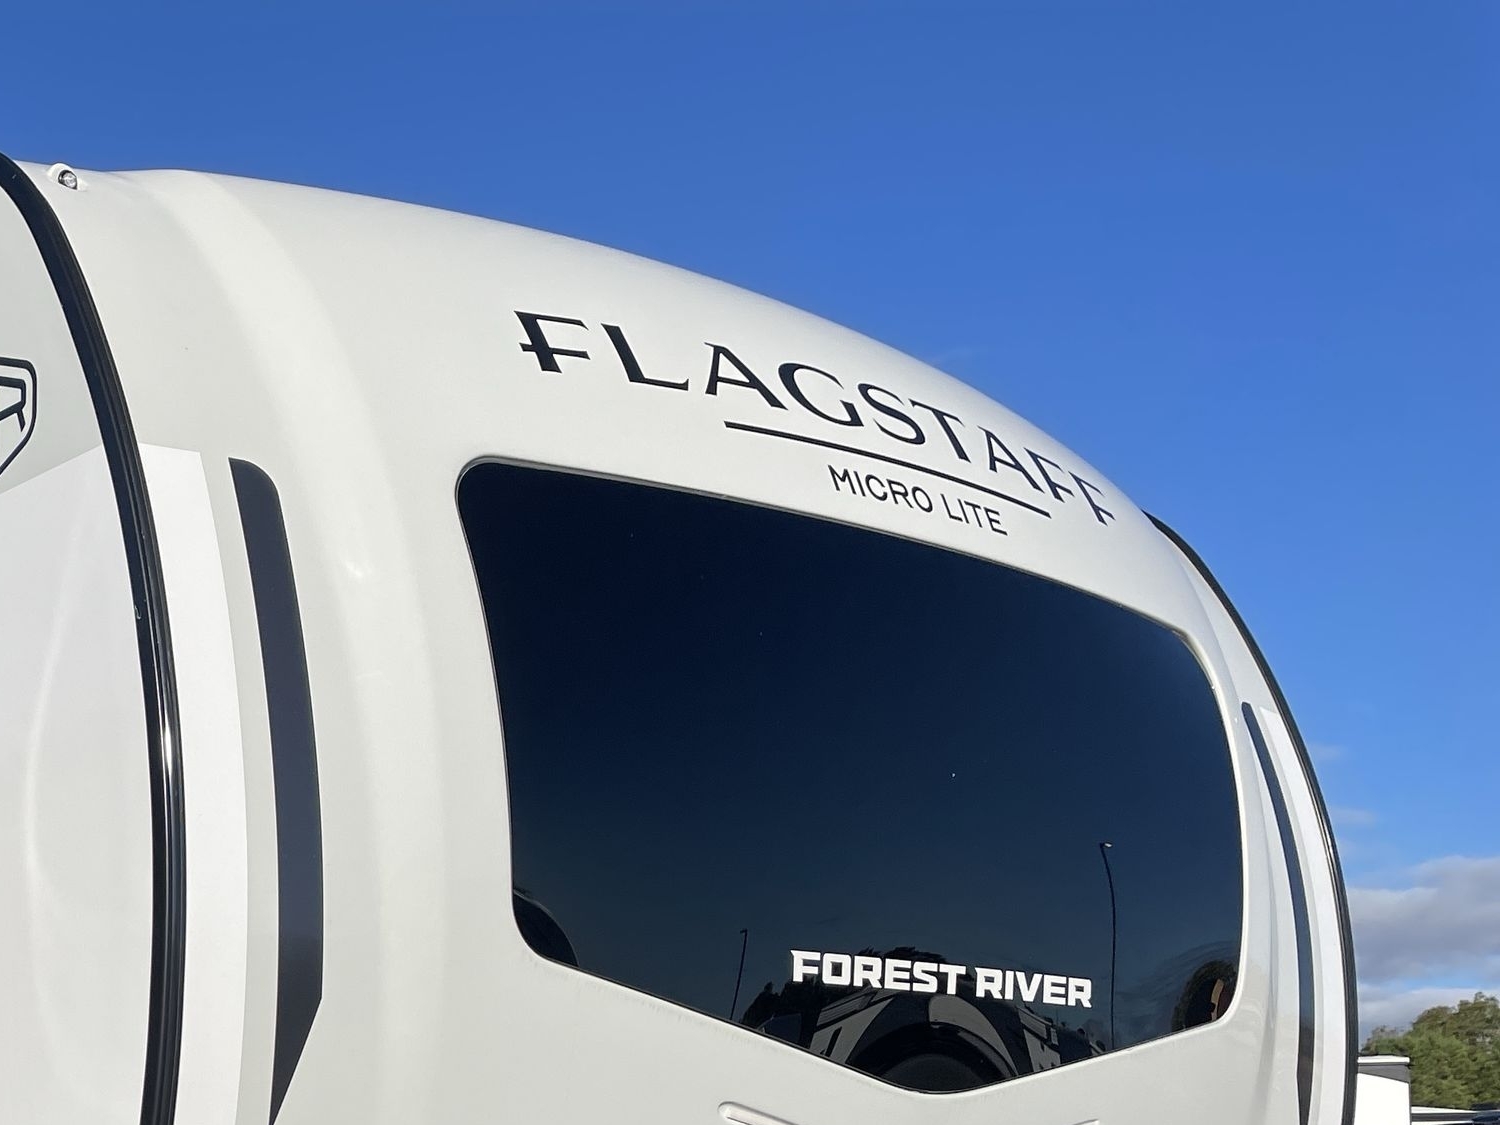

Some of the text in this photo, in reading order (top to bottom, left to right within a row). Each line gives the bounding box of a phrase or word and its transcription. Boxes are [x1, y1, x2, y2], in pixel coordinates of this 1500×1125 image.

[514, 310, 1116, 525] FLAGSTAFF
[827, 464, 1008, 537] MICRO LITE
[790, 949, 1093, 1009] FOREST RIVER
